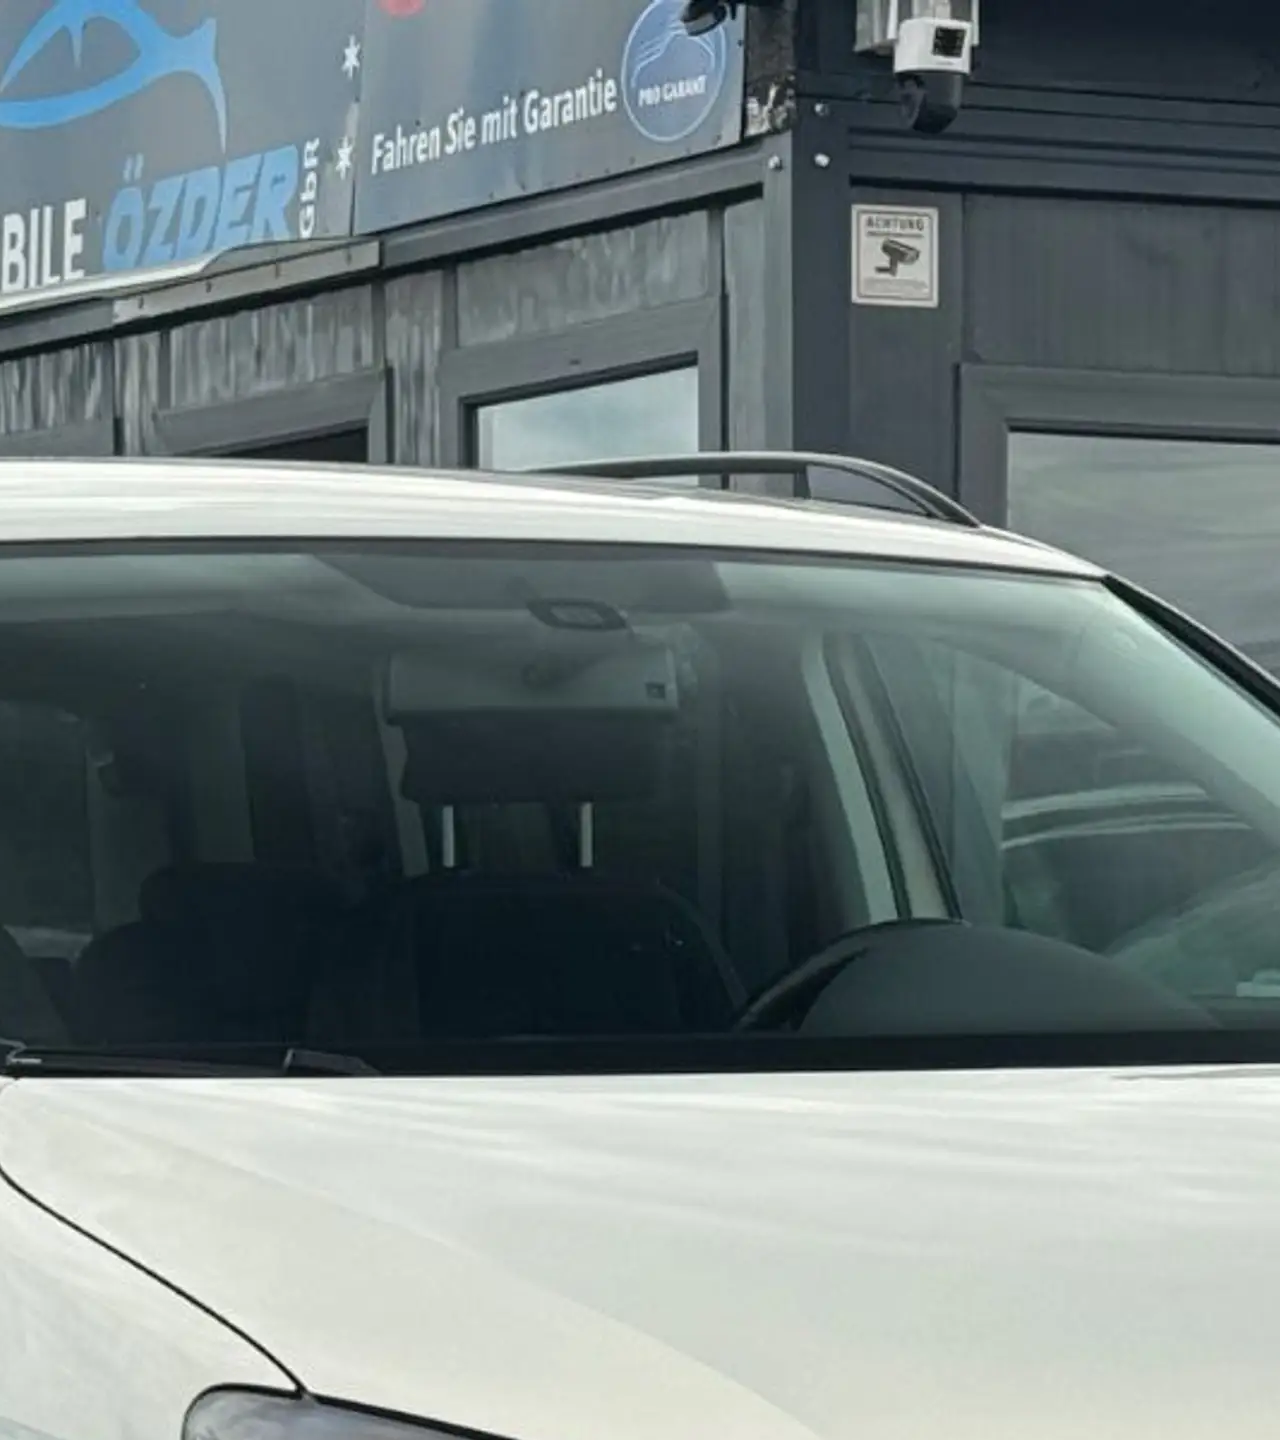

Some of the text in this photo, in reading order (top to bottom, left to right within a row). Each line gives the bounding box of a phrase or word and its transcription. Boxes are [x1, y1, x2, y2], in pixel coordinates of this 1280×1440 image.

[371, 68, 618, 176] Fahren Sie mit Garantie
[101, 144, 300, 274] ÖZDER
